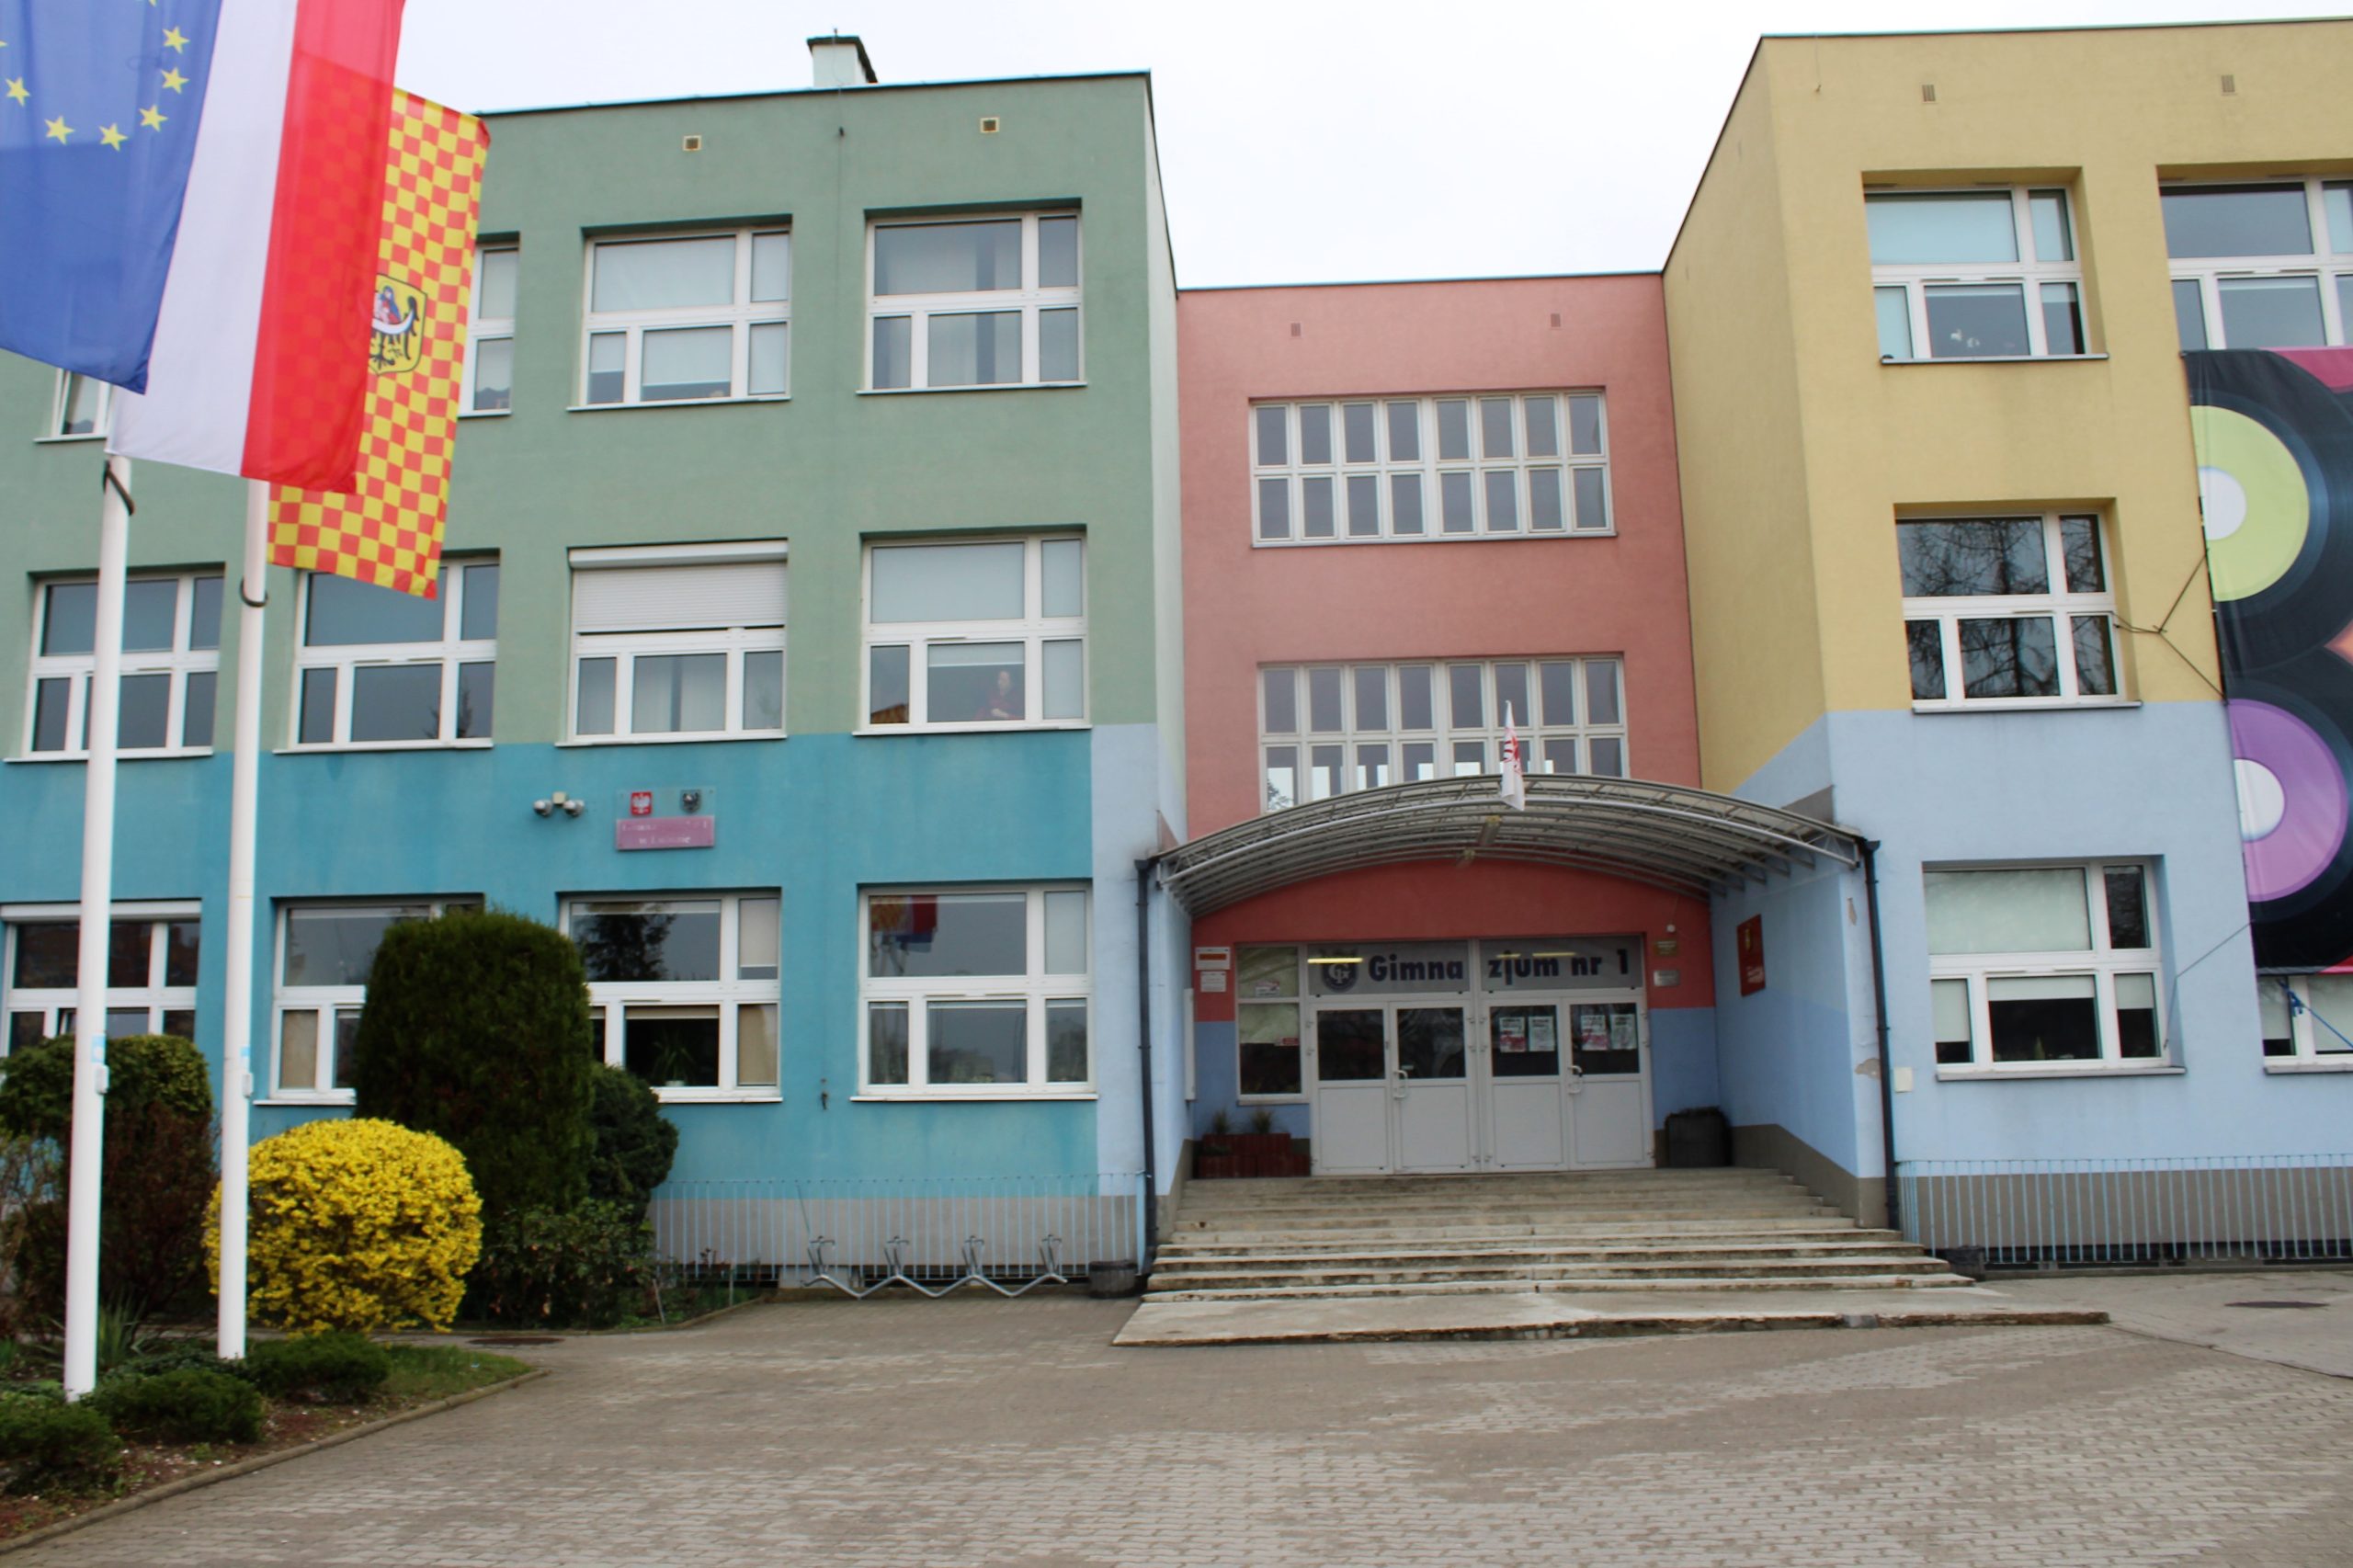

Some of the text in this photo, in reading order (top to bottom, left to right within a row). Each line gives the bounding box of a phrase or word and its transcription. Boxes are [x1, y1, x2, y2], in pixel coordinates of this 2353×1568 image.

[1369, 949, 1629, 985] Gimna zjum nr 1
